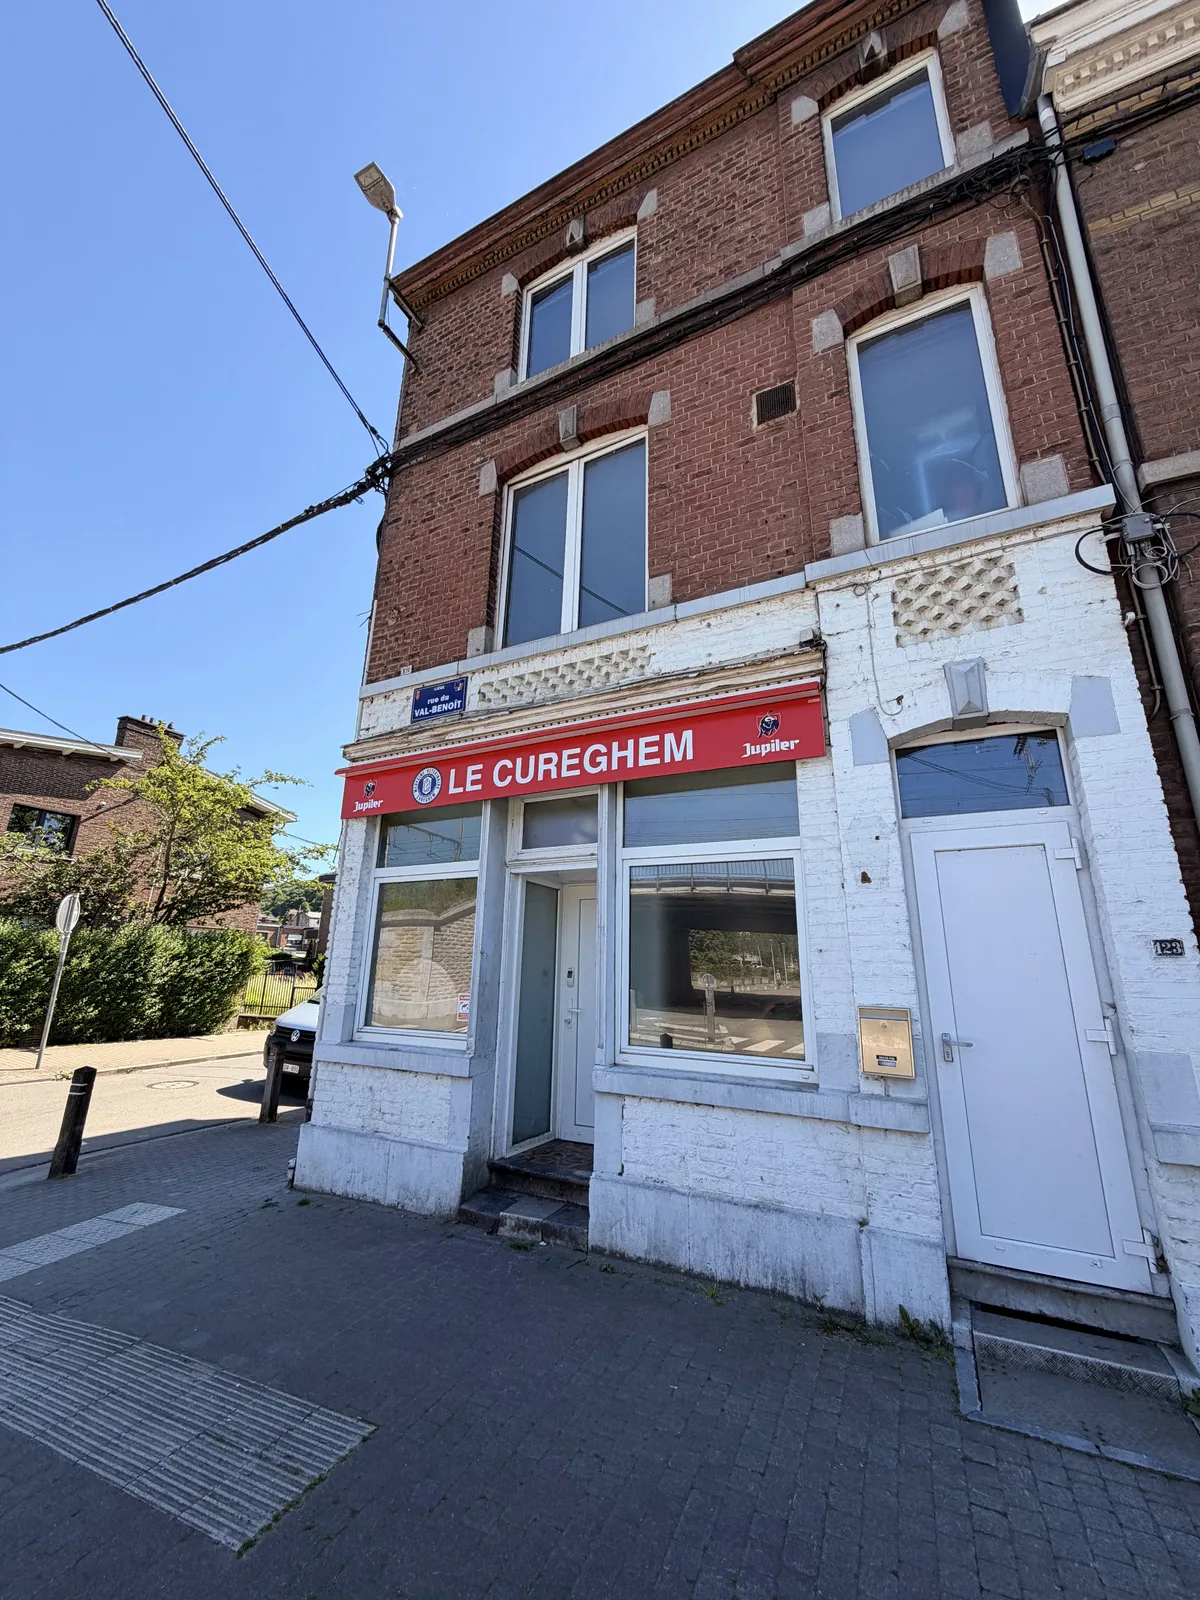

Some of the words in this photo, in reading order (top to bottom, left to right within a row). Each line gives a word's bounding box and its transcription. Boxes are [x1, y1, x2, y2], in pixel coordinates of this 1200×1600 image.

[440, 694, 450, 702] du
[414, 699, 462, 717] VAL-BENOÎT
[741, 738, 800, 758] Jupiler
[448, 763, 484, 795] LE
[492, 729, 694, 788] CUREGHEM
[352, 799, 384, 813] Jupiler
[1155, 941, 1182, 954] 123
